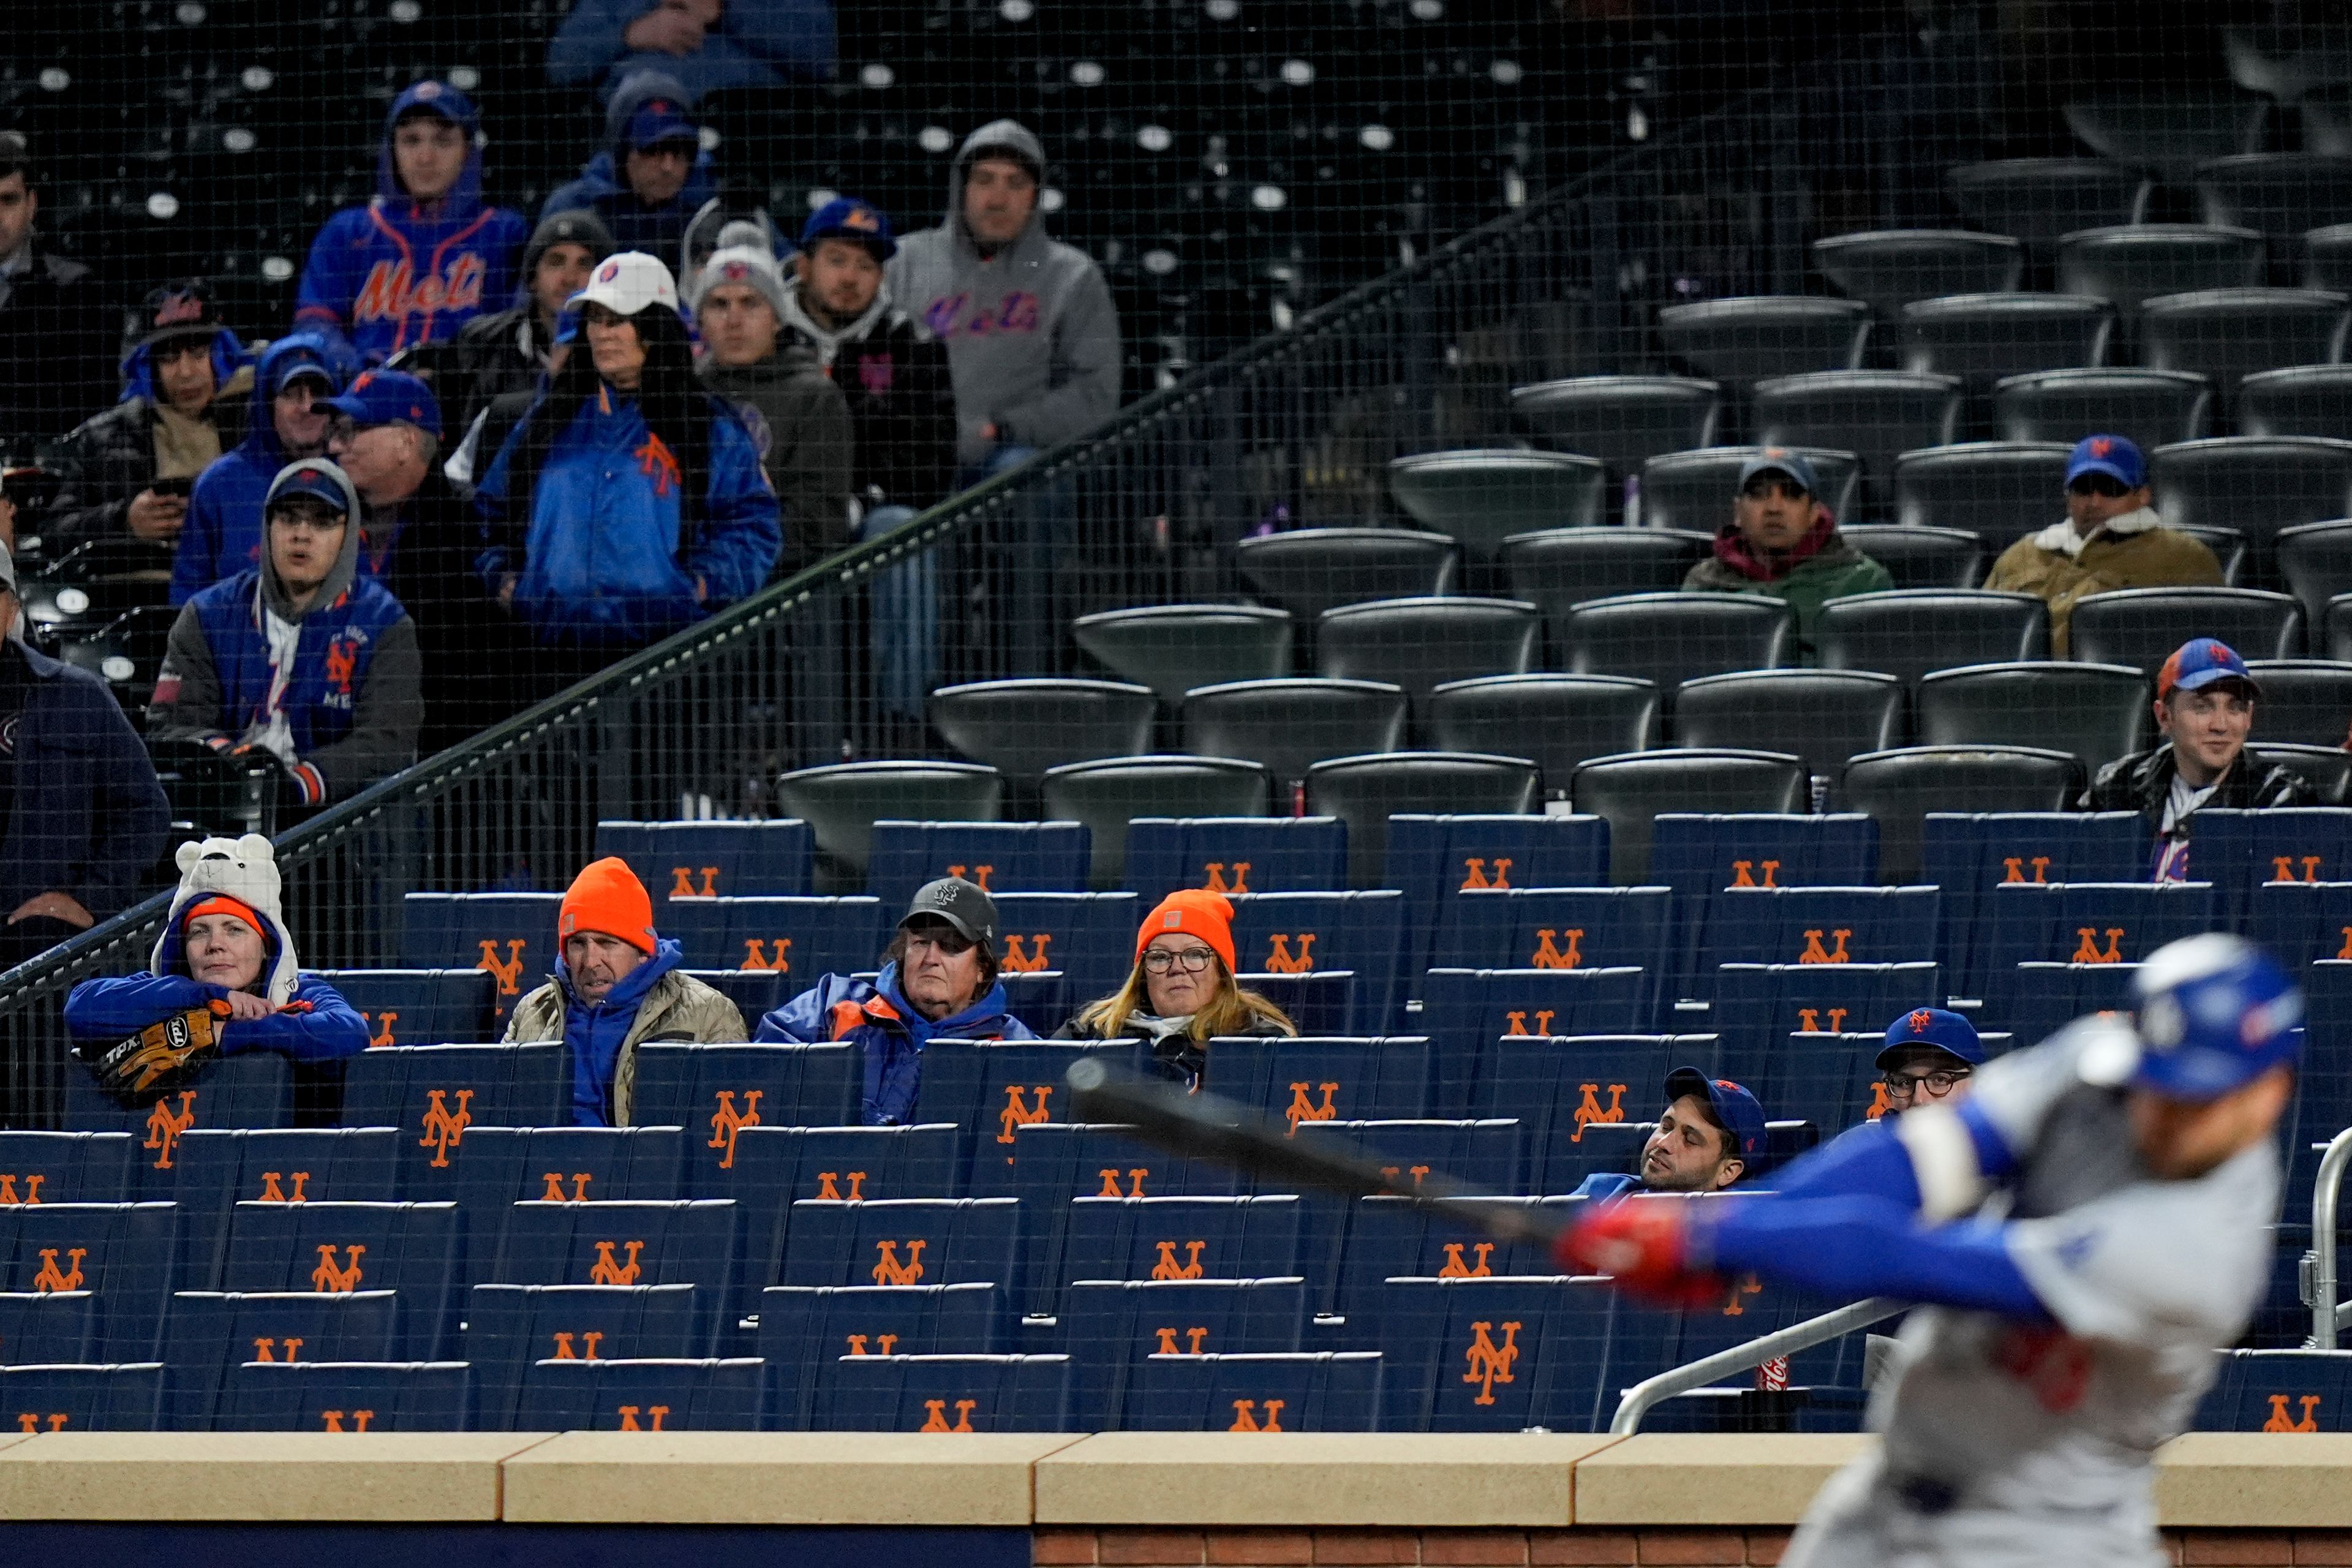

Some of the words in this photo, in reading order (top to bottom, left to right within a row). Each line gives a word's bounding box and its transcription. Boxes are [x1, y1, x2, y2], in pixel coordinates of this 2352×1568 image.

[173, 1018, 186, 1046] TPX
[105, 1035, 141, 1065] TPX
[1464, 1322, 1521, 1405] NY
